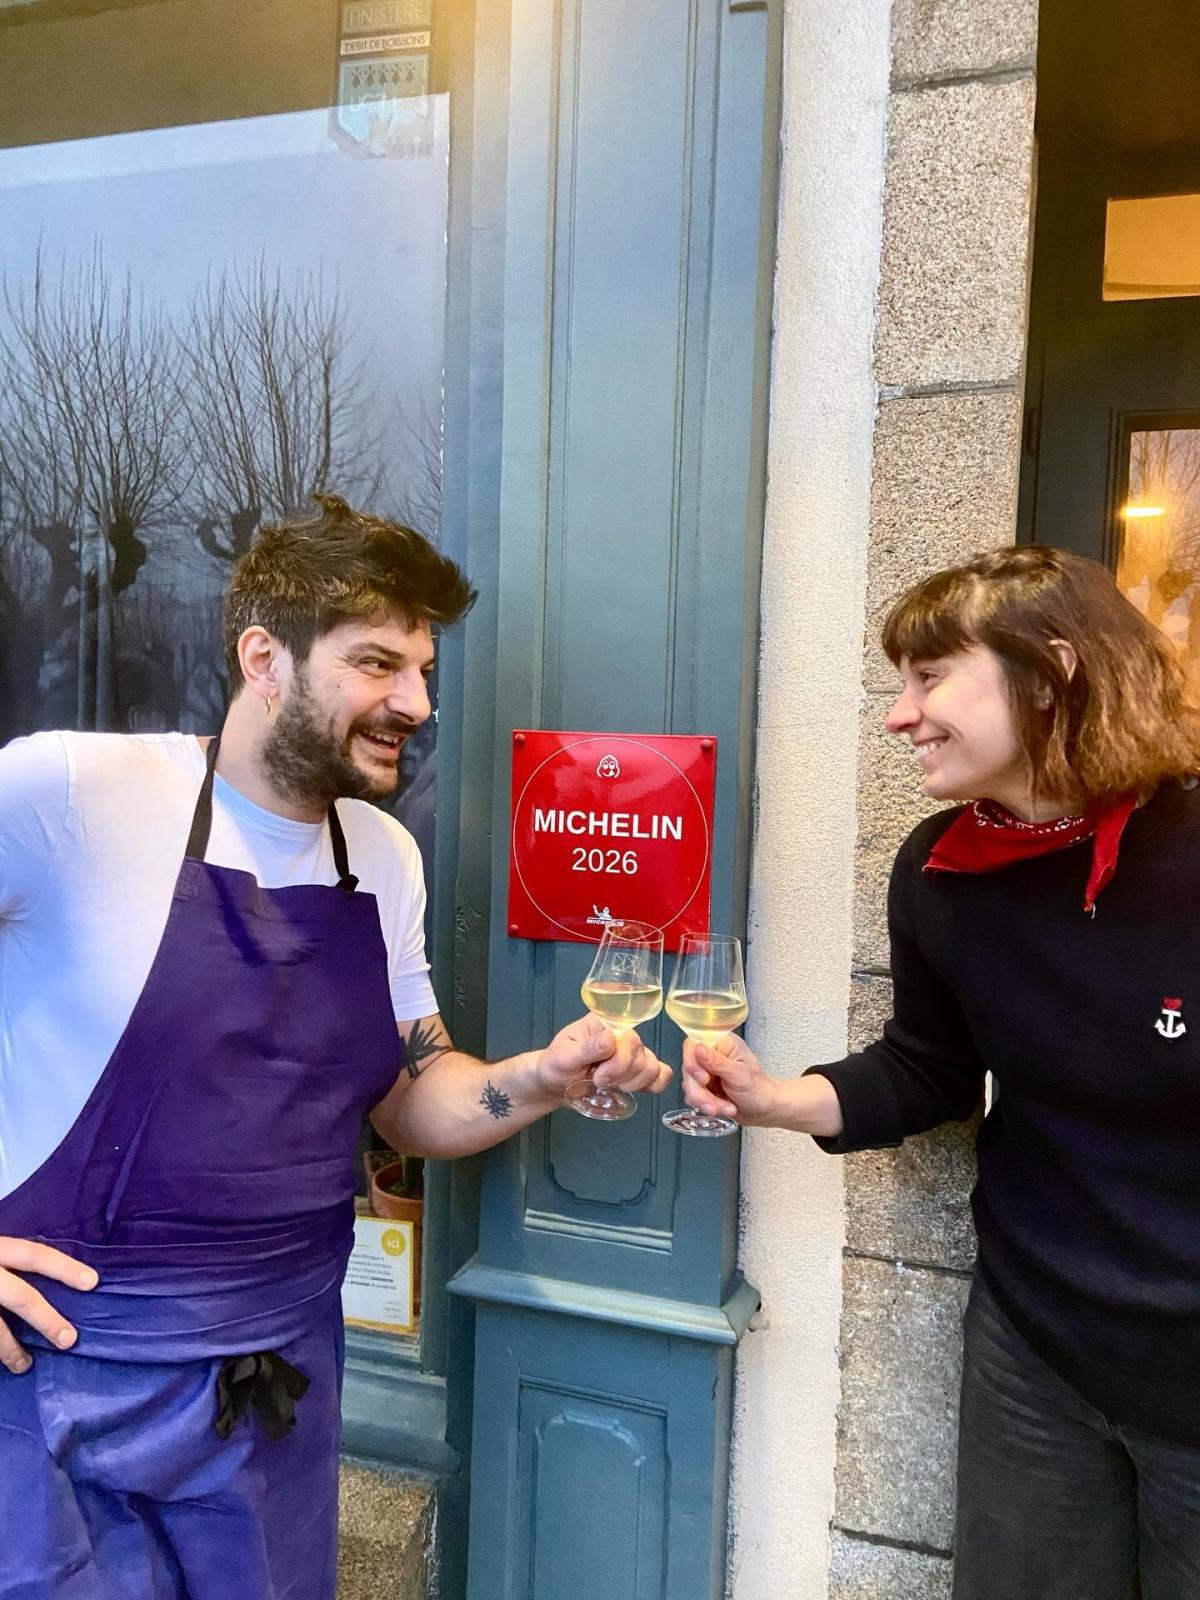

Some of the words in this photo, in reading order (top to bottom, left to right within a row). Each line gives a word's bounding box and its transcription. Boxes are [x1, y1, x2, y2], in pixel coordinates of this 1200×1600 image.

[345, 40, 367, 52] DEBIT
[369, 40, 379, 49] DE
[382, 35, 426, 48] BOISSONS
[534, 808, 683, 840] MICHELIN
[572, 847, 638, 875] 2026
[586, 917, 625, 927] MICHELIN
